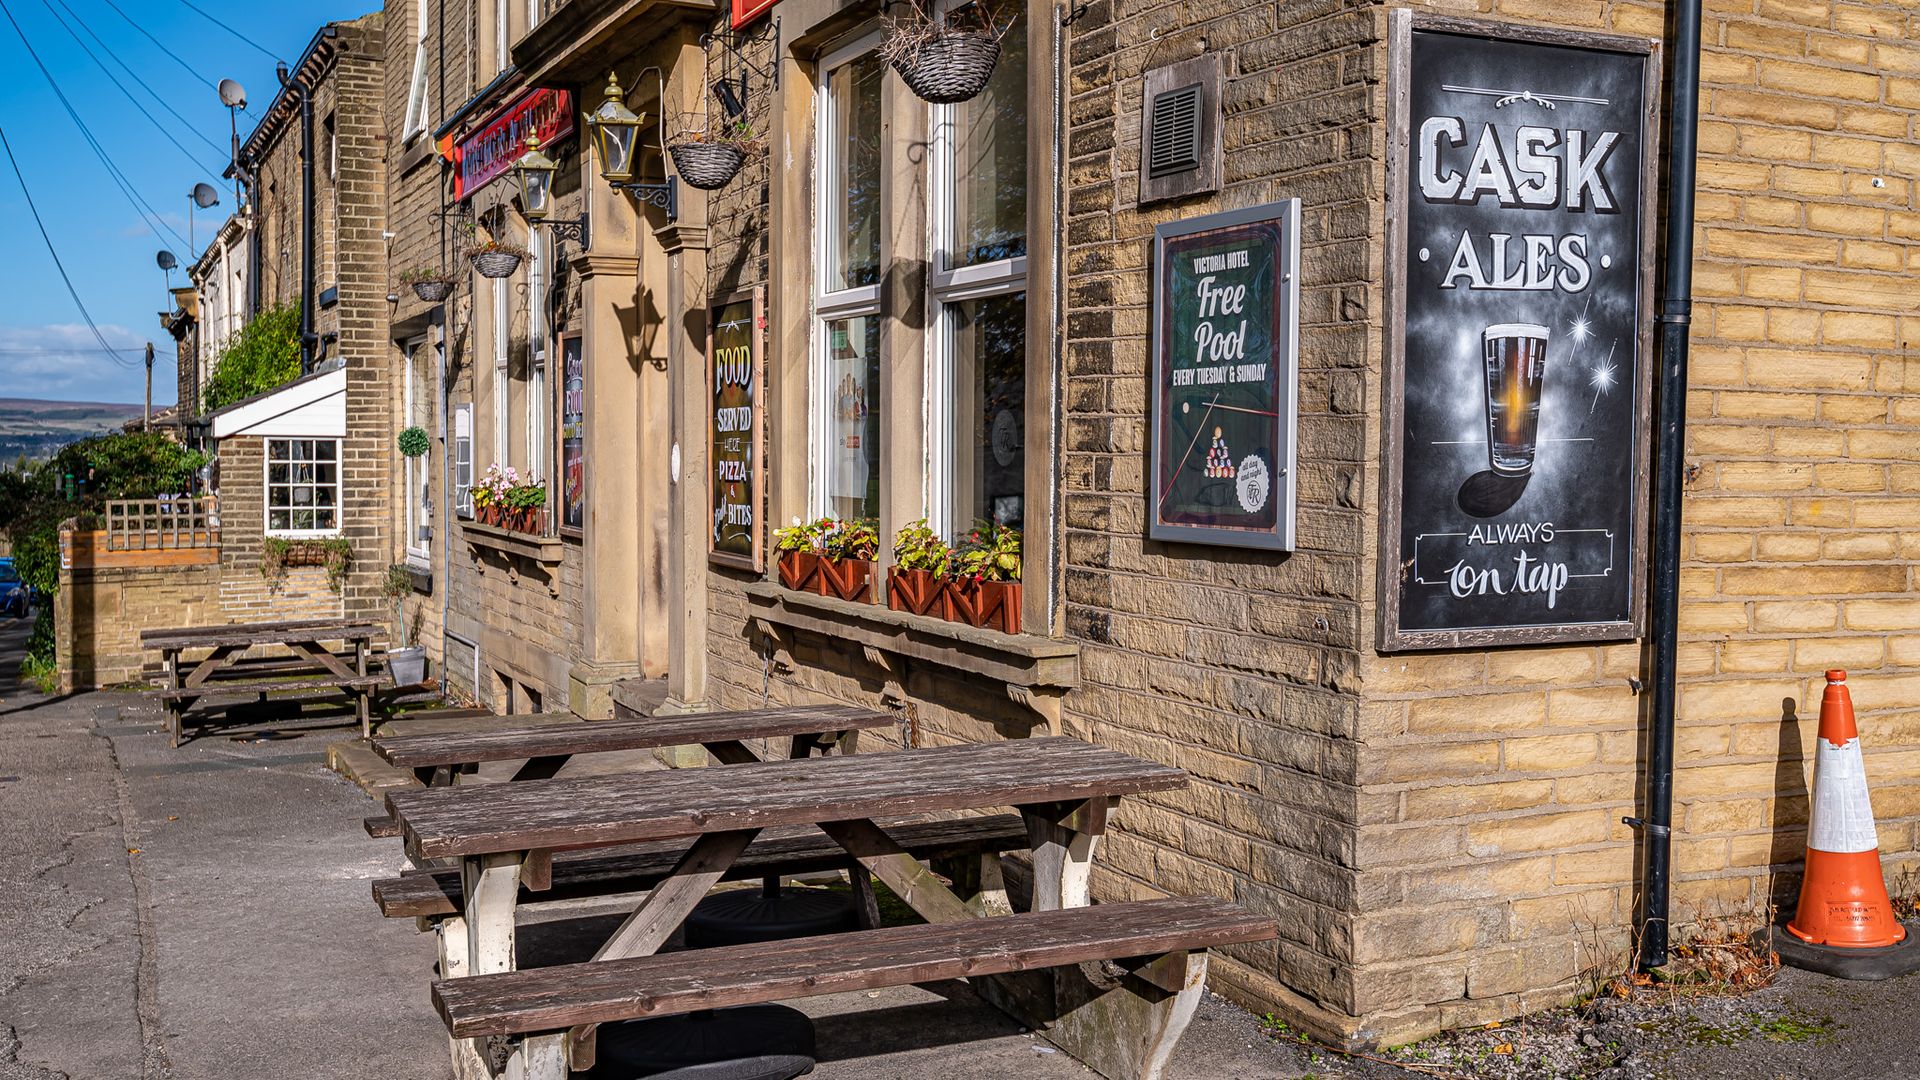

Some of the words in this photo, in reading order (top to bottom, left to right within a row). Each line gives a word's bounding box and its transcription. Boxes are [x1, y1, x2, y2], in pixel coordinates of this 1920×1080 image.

[1418, 116, 1622, 213] CASK
[1193, 254, 1226, 274] VICTORIA
[1227, 250, 1249, 269] HOTEL
[1440, 228, 1591, 292] ALES
[1197, 276, 1246, 318] Free
[1194, 319, 1247, 363] Pool
[716, 345, 751, 394] FOOD
[1173, 368, 1195, 387] EVERY
[1196, 365, 1228, 384] TUESDAY
[1229, 365, 1236, 383] &
[1236, 363, 1267, 382] SUNDAY
[717, 406, 751, 432] SERVED
[724, 437, 741, 453] HERE
[719, 461, 747, 481] PIZZA
[1241, 471, 1249, 481] and
[1250, 467, 1262, 479] night
[1249, 460, 1258, 469] day
[728, 503, 751, 526] BITES
[1467, 522, 1555, 545] ALWAYS
[1511, 550, 1569, 609] tap
